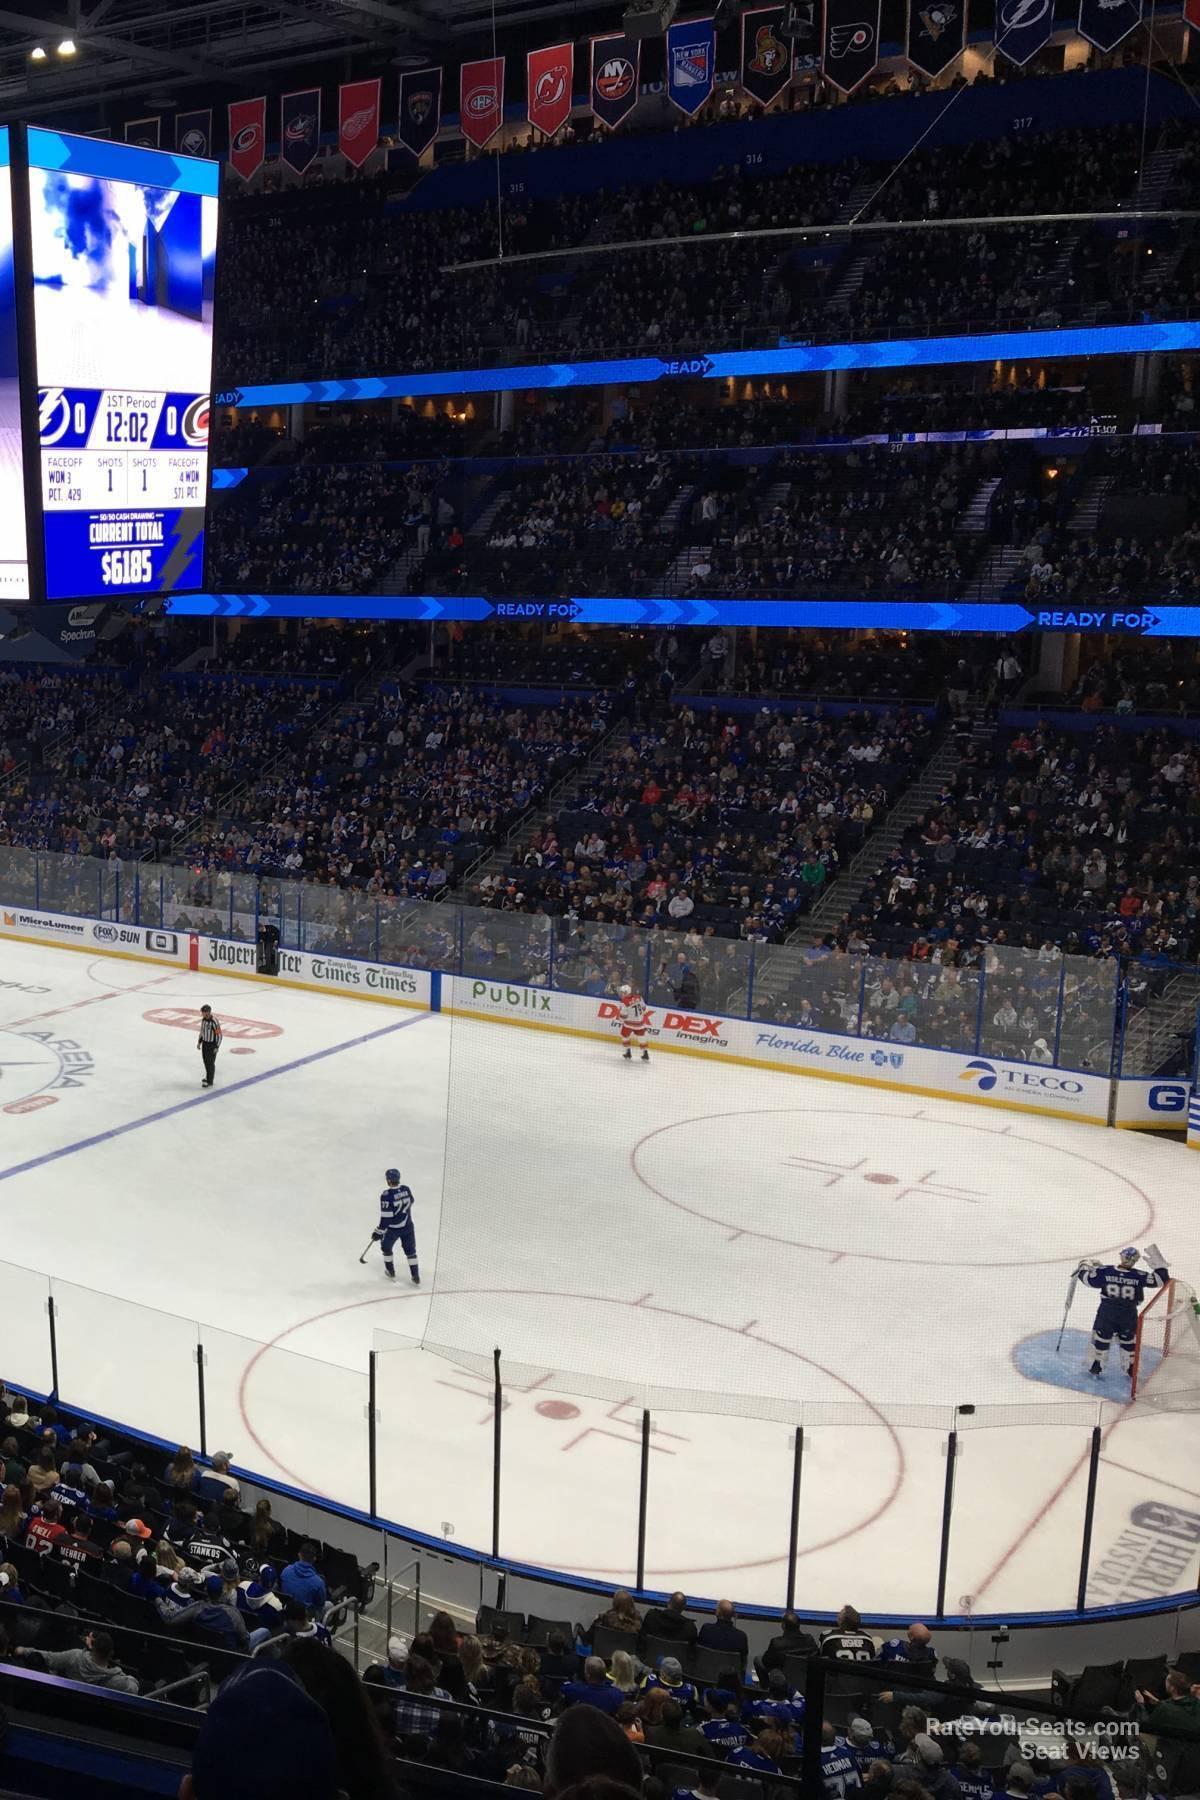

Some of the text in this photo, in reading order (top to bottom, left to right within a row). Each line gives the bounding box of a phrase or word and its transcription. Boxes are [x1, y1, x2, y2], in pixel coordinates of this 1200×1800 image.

[107, 395, 157, 409] 1ST Period
[106, 411, 149, 443] 12:02
[47, 457, 83, 467] FACEOFF
[97, 457, 123, 468] SHOTS
[132, 458, 157, 468] SHOTS
[168, 458, 200, 468] FACEOFF
[107, 468, 112, 492] 1
[142, 468, 147, 492] 1
[116, 513, 131, 521] CASH
[131, 512, 155, 520] DRAWING
[89, 521, 164, 544] CURRENT TOTAL
[101, 549, 153, 585] $6185
[496, 603, 544, 617] READY
[1037, 612, 1106, 627] READY
[60, 629, 96, 644] Spectrum
[19, 915, 84, 933] MicroLumen
[119, 930, 141, 945] SUN
[312, 959, 361, 985] Times
[364, 967, 417, 994] Times
[472, 980, 551, 1012] Publix
[663, 1013, 724, 1037] DEX
[676, 1032, 729, 1047] imaging
[756, 1033, 865, 1063] Florida Blue
[1001, 1070, 1084, 1094] TECO
[393, 1196, 411, 1215] 77
[1106, 1284, 1136, 1301] 88
